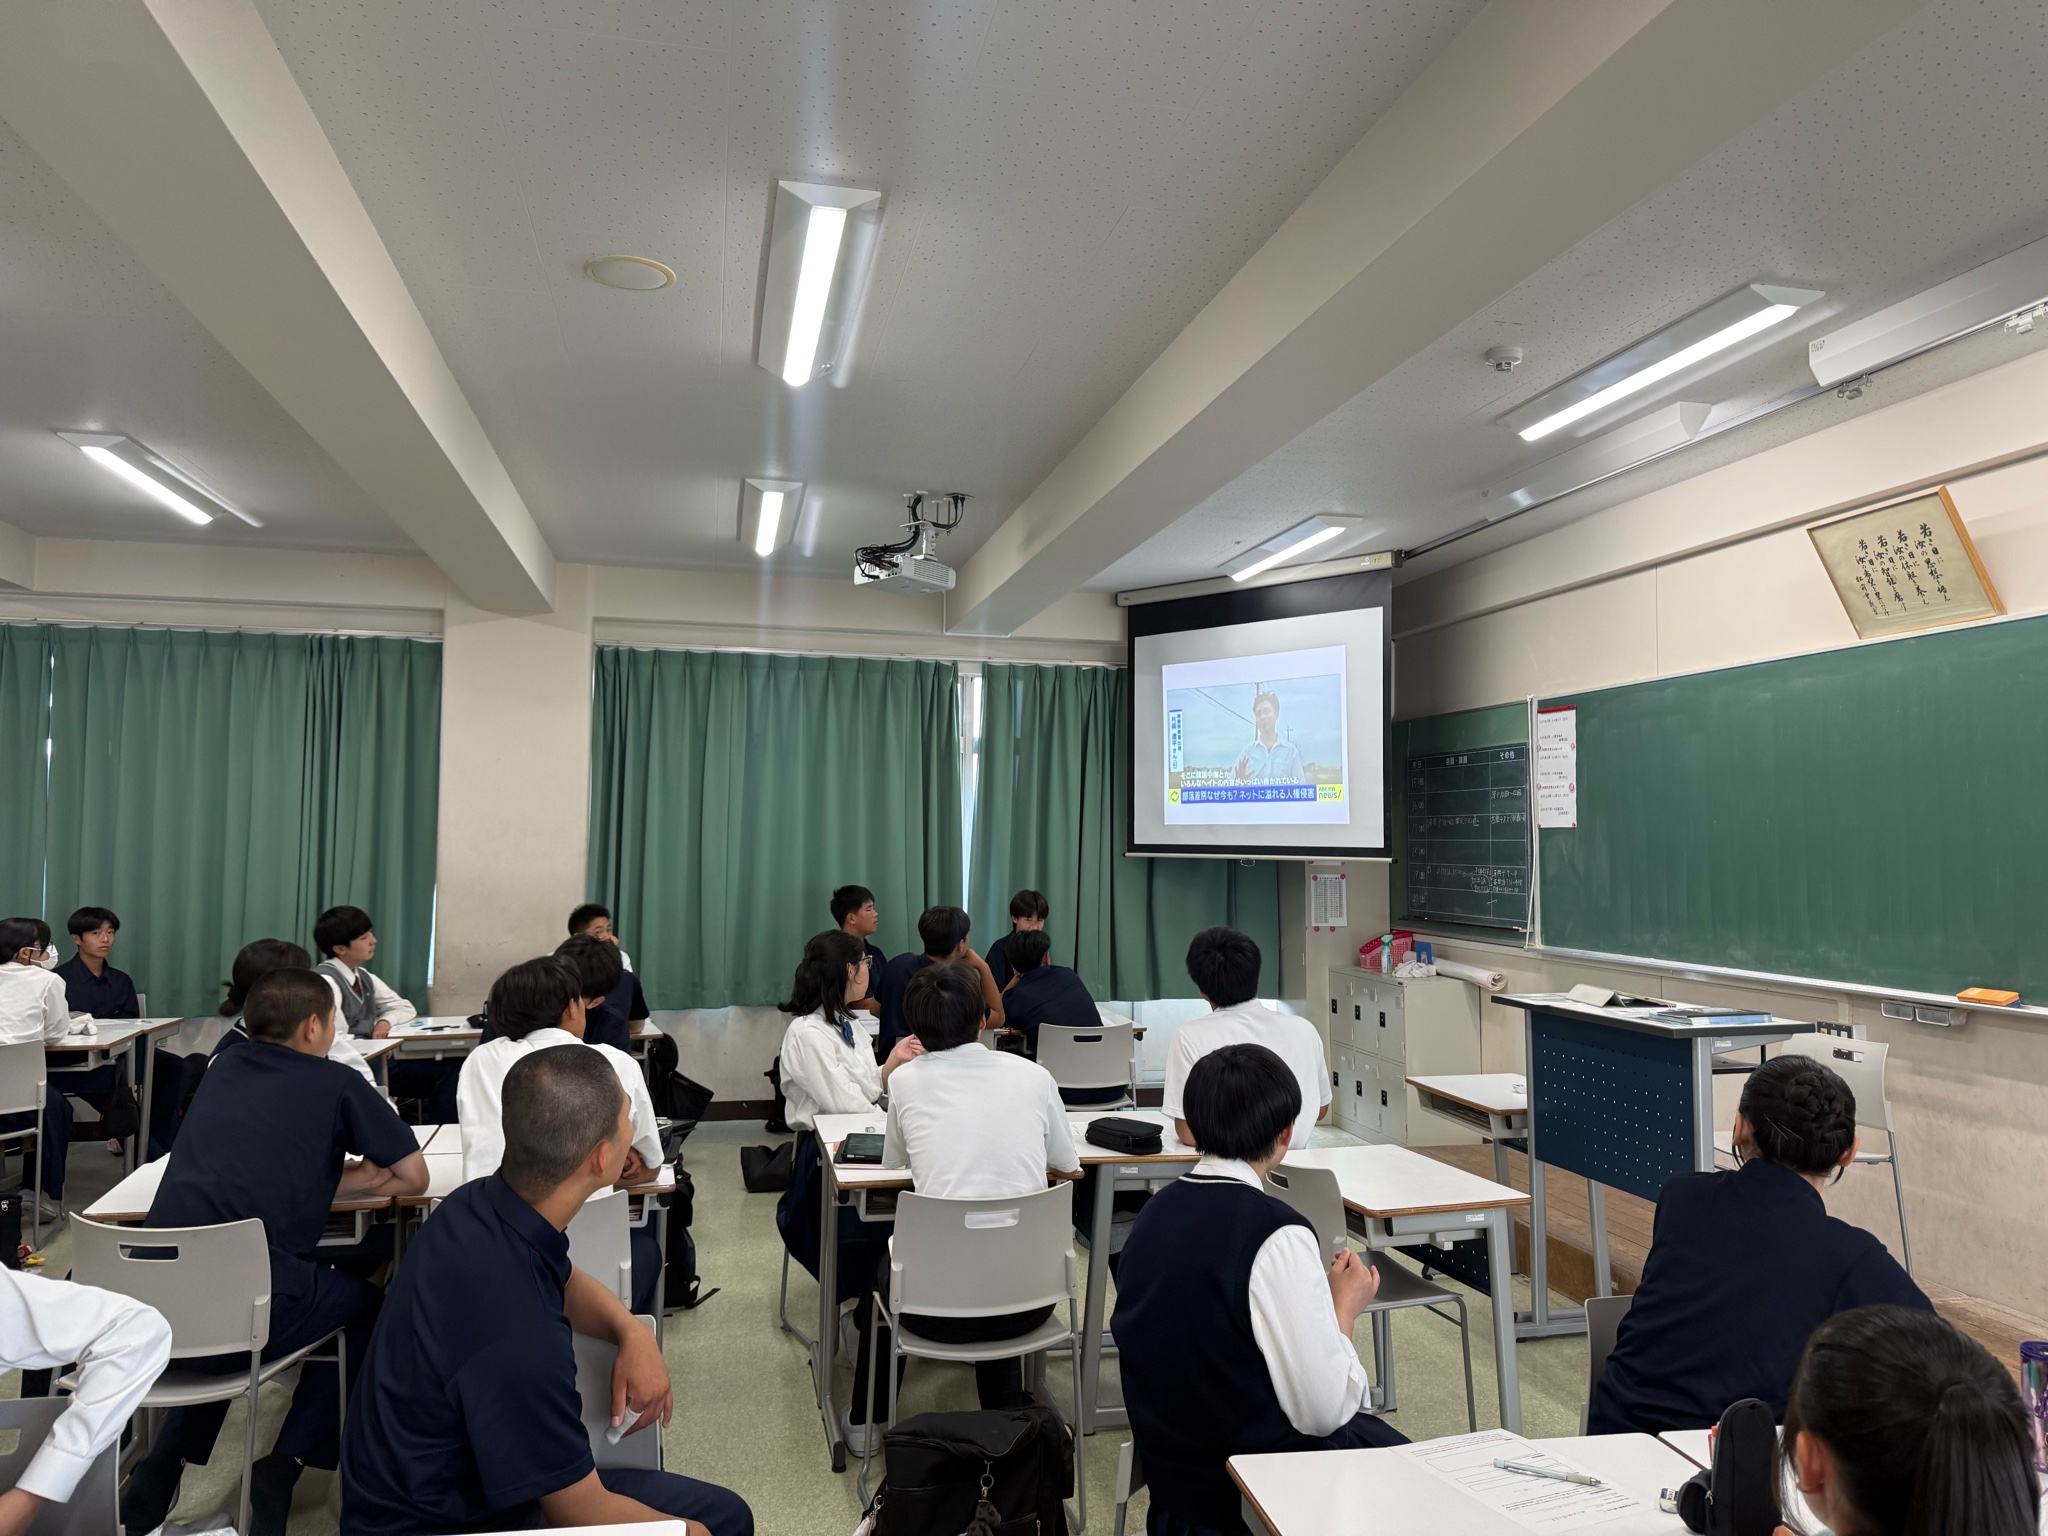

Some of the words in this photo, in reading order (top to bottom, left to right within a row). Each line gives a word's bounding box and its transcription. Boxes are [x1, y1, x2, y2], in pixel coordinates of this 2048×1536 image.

[1858, 538, 1878, 573] 若き日に
[1877, 534, 1898, 571] 若き日に
[1896, 529, 1920, 567] 若き日に
[1919, 522, 1944, 564] 若き日に
